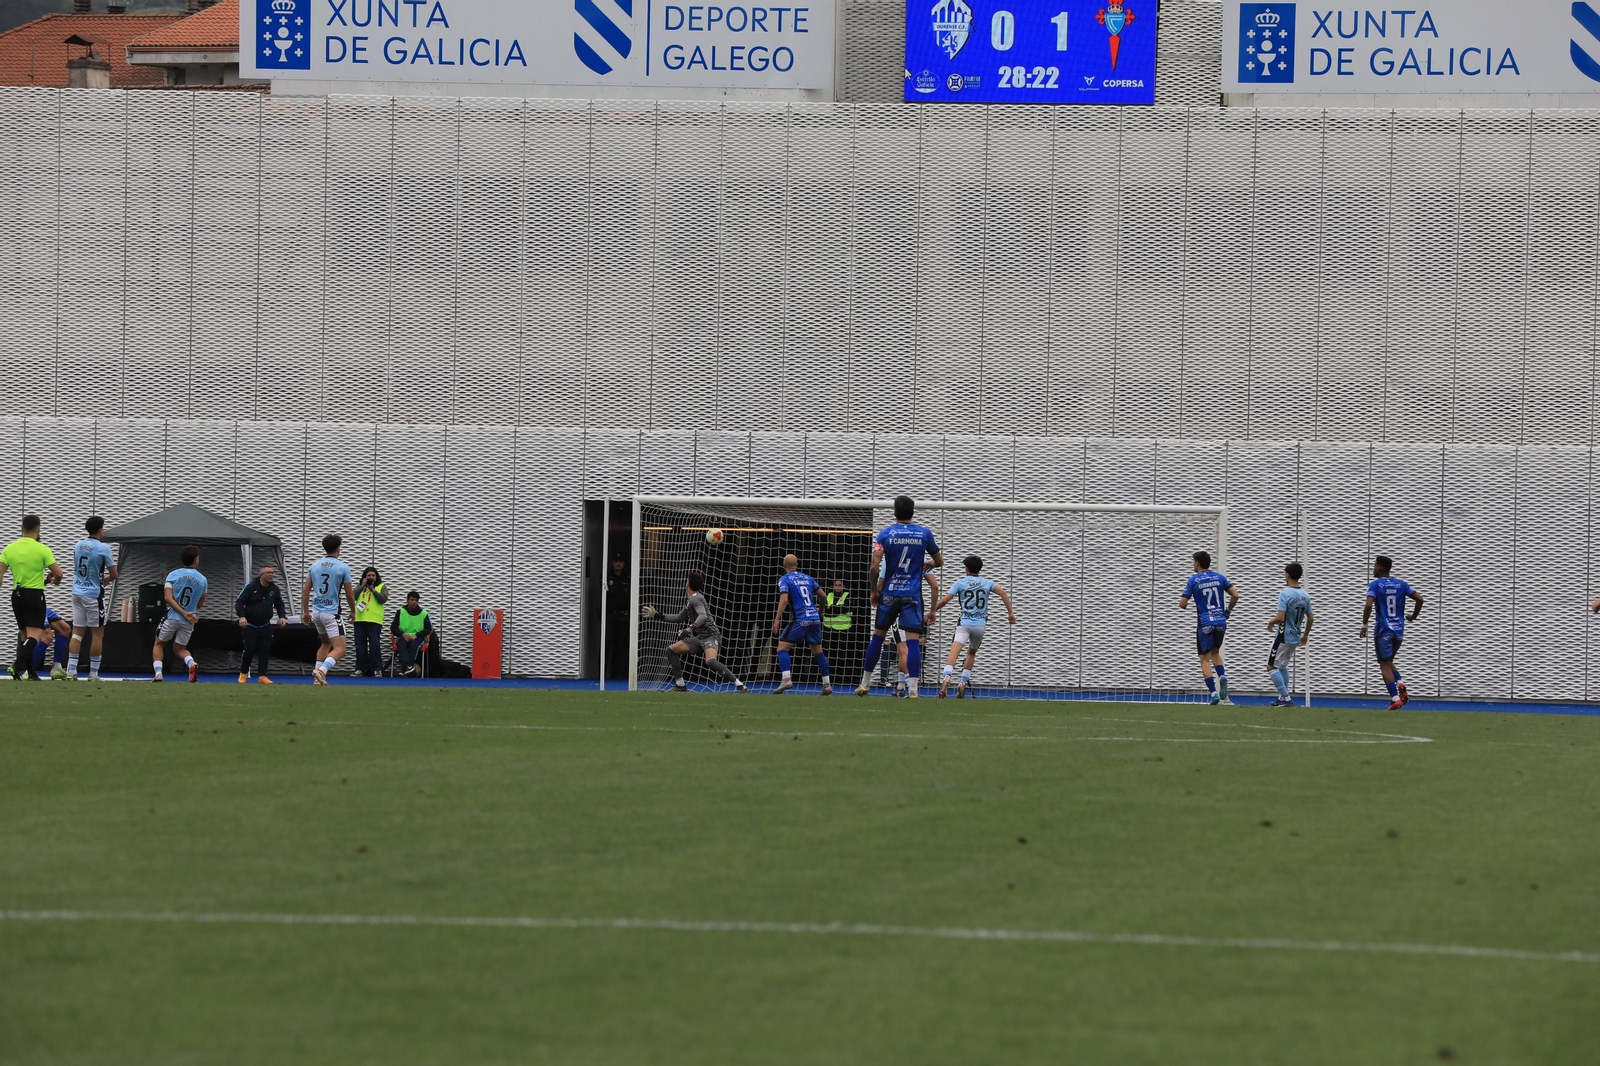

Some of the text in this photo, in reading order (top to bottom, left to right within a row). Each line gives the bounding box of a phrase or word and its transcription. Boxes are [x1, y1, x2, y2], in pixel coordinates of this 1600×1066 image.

[326, 0, 450, 28] XUNTA
[665, 5, 809, 33] DEPORTE
[1311, 10, 1439, 38] XUNTA
[991, 10, 1015, 51] 0
[1050, 11, 1068, 51] 1
[325, 35, 528, 67] DE GALICIA
[663, 44, 795, 72] GALEGO
[1309, 47, 1520, 76] DE GALICIA
[998, 65, 1060, 89] 28:22
[1103, 79, 1144, 88] COPERSA
[78, 555, 89, 578] 5
[898, 546, 911, 573] 4
[319, 572, 331, 595] 3
[799, 585, 812, 607] 9
[179, 586, 194, 608] 6
[964, 588, 986, 610] 26
[1202, 587, 1222, 609] 21
[1386, 595, 1397, 617] 8
